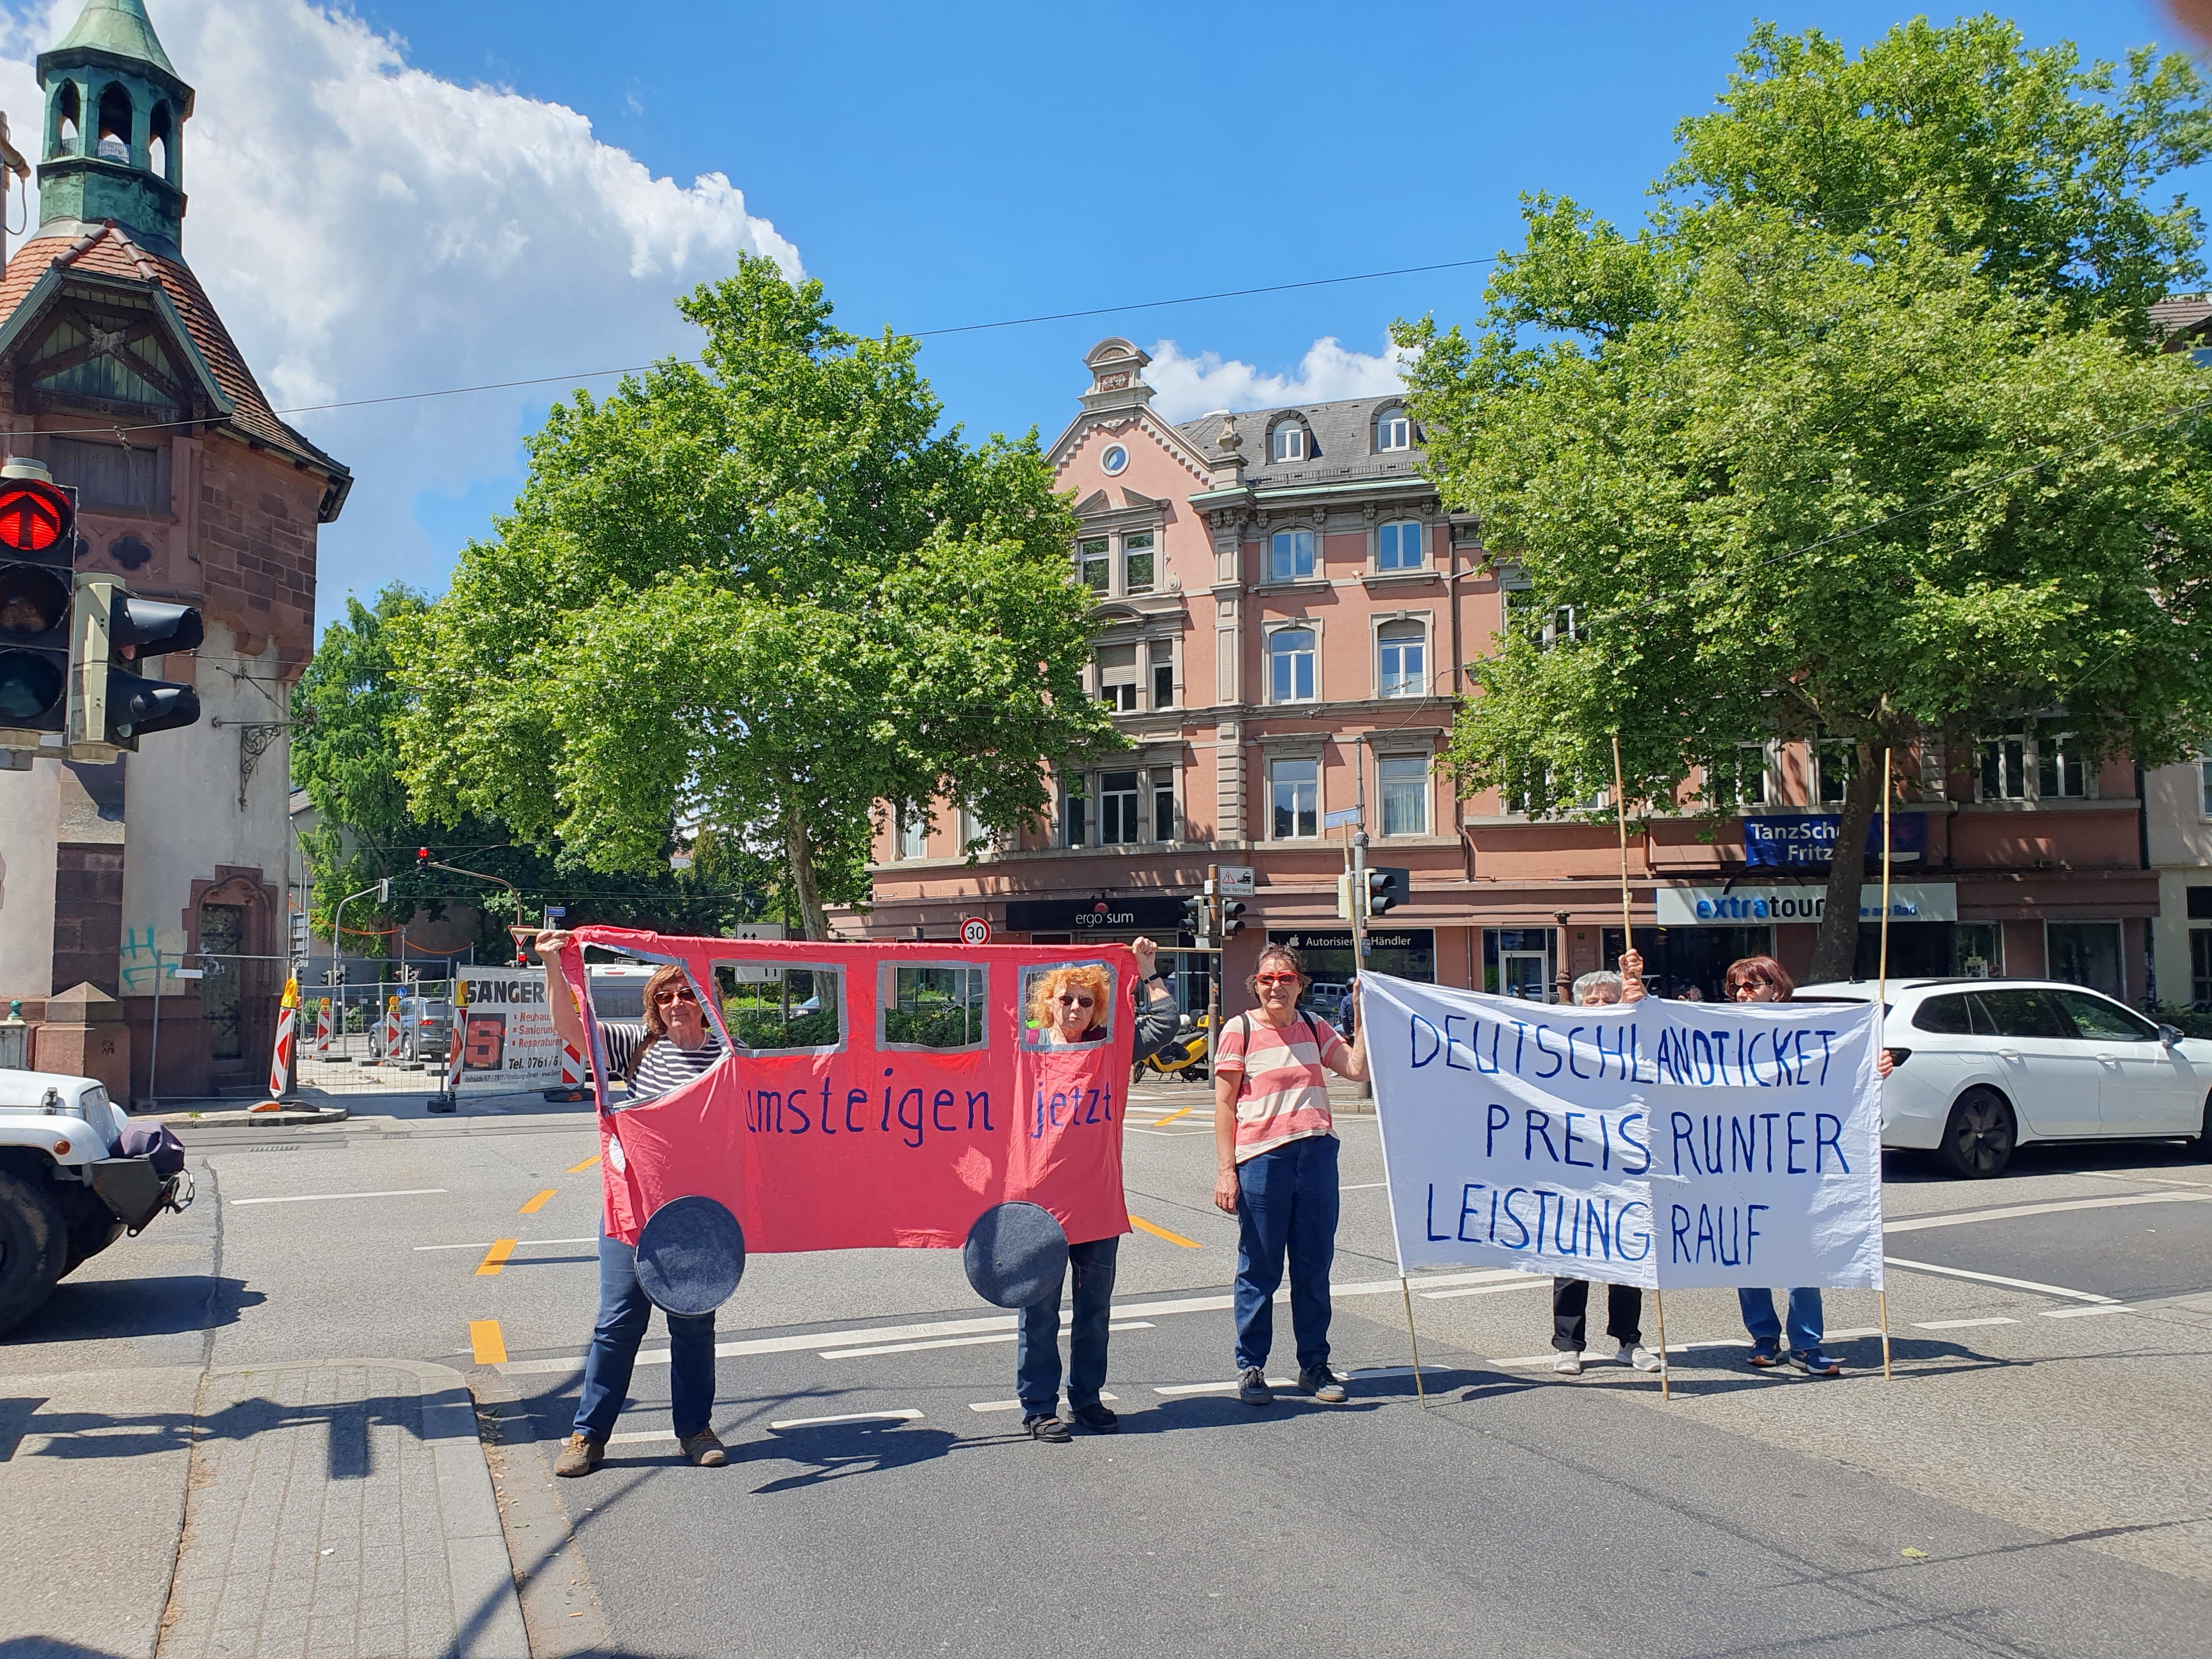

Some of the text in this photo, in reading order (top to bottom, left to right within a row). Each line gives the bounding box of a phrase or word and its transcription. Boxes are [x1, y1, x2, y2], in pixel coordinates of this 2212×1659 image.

[1751, 822, 1840, 840] TanzSch
[1788, 844, 1833, 861] Fritz
[1696, 896, 1825, 919] extratour
[1076, 912, 1134, 927] ergo sum
[967, 926, 984, 940] 30
[1306, 936, 1412, 946] Autorisier Händler
[467, 980, 545, 1003] SÄNGER
[1410, 1013, 1836, 1088] DEUTSCHLANDTICKET
[508, 1057, 524, 1069] Tel.
[742, 1068, 1112, 1148] umsteigen jetzt
[1486, 1104, 1850, 1176] PREIS RUNTER
[1427, 1183, 1769, 1266] LEISTUNG RAUF
